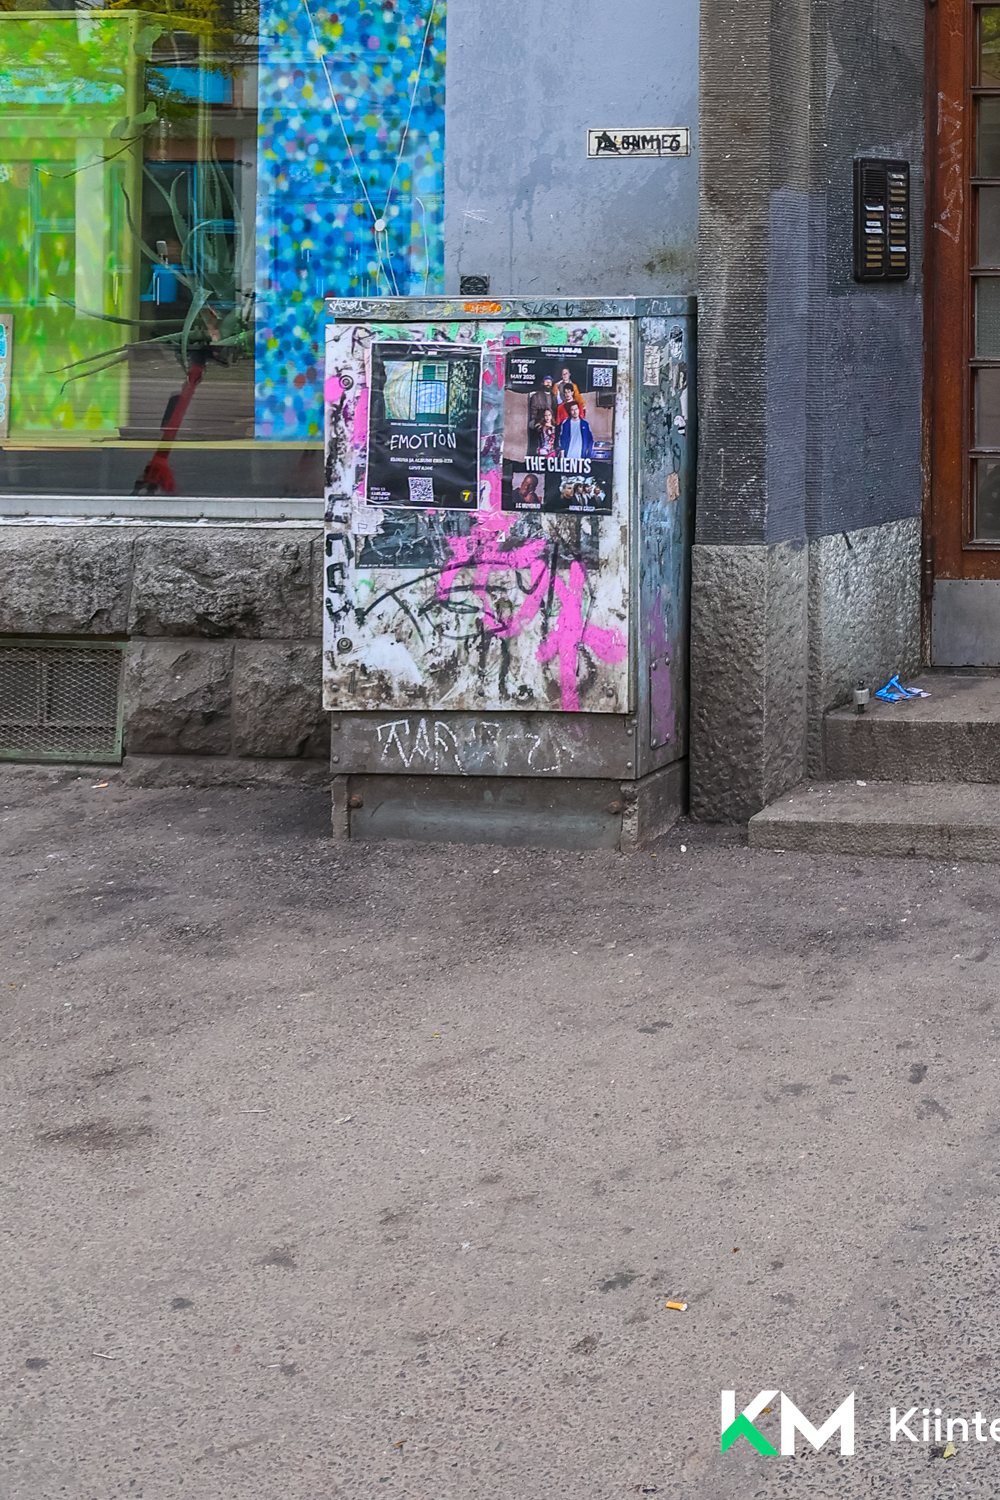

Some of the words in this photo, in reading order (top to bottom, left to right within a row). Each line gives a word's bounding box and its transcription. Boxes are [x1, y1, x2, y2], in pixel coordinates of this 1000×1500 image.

[517, 363, 529, 374] 16
[524, 456, 546, 472] THE
[547, 458, 592, 474] CLIENTS
[461, 489, 472, 501] 7
